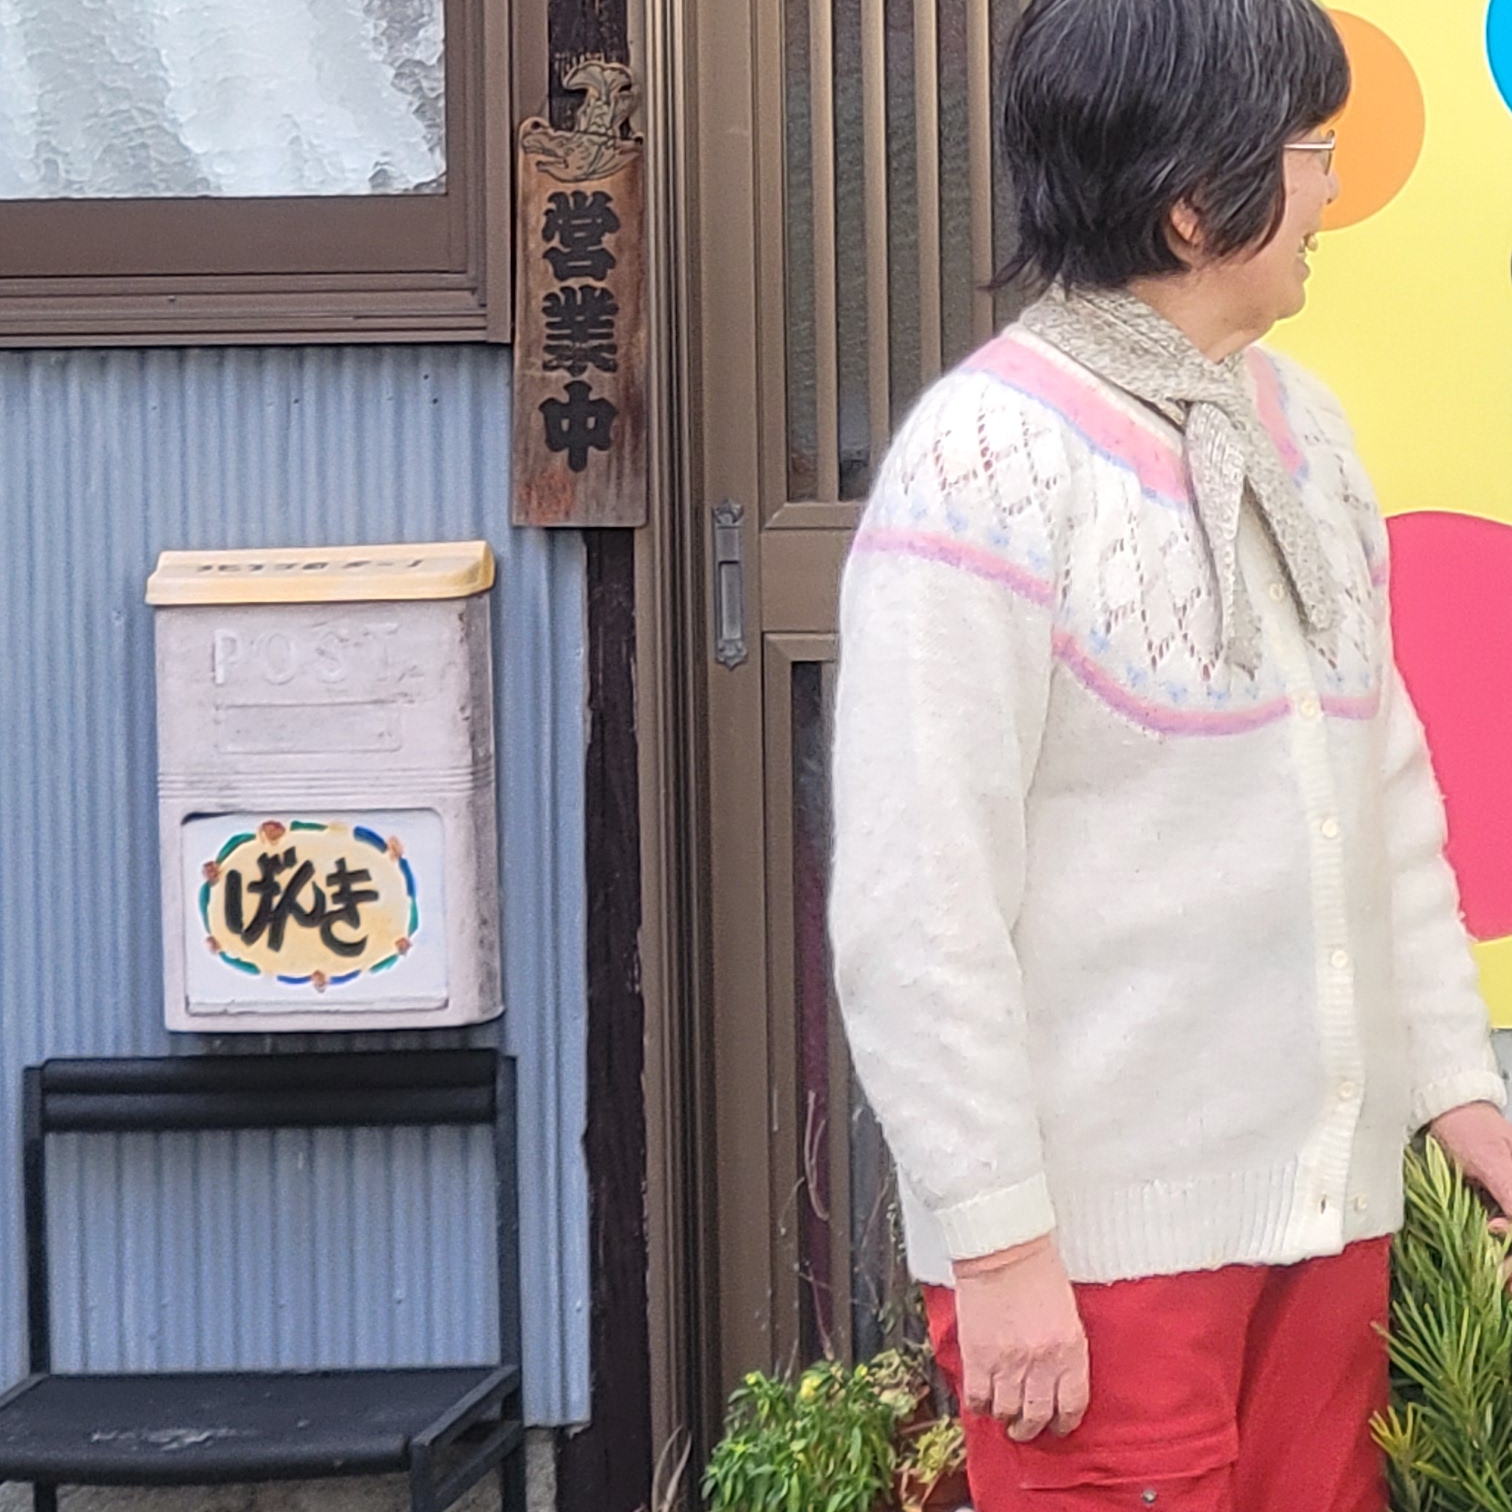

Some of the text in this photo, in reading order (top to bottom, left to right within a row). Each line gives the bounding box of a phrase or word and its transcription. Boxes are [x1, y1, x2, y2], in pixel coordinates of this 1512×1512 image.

[538, 190, 621, 472] 営業中
[212, 622, 399, 684] POST
[224, 846, 379, 957] げんき
